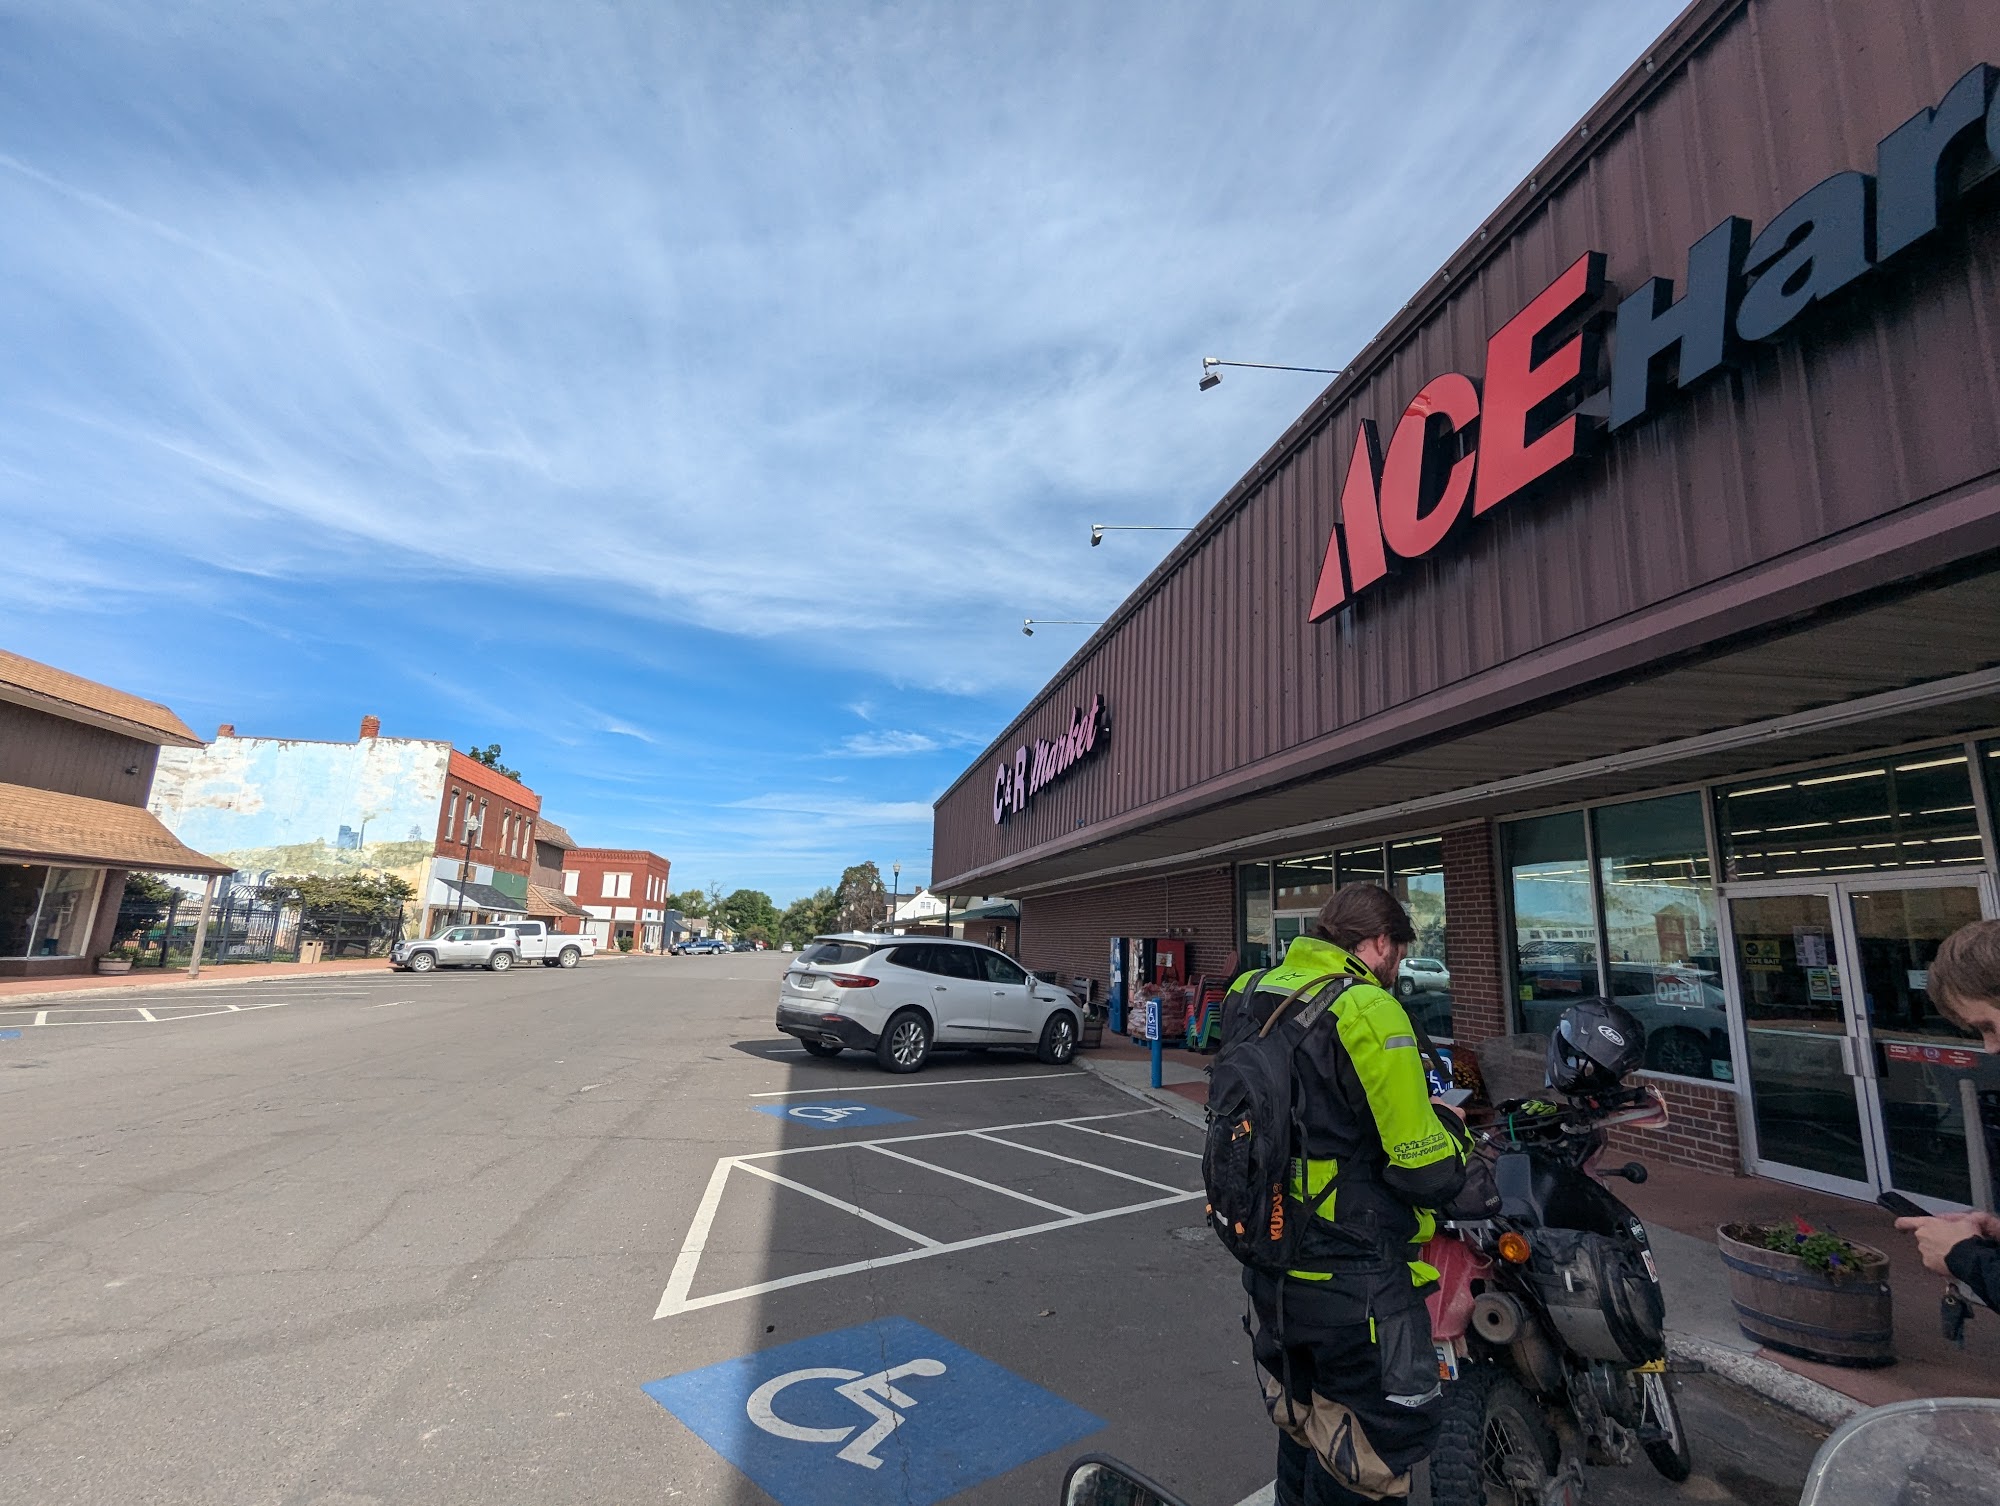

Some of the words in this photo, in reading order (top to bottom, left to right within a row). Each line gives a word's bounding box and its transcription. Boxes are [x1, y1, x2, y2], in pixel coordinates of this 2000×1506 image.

[1308, 250, 1592, 624] ACE
[1609, 62, 2000, 434] Har
[993, 762, 1006, 825] C
[1012, 745, 1028, 814] R
[1029, 693, 1102, 797] Market
[1657, 981, 1702, 1003] OPEN
[1270, 1193, 1284, 1241] KUDU
